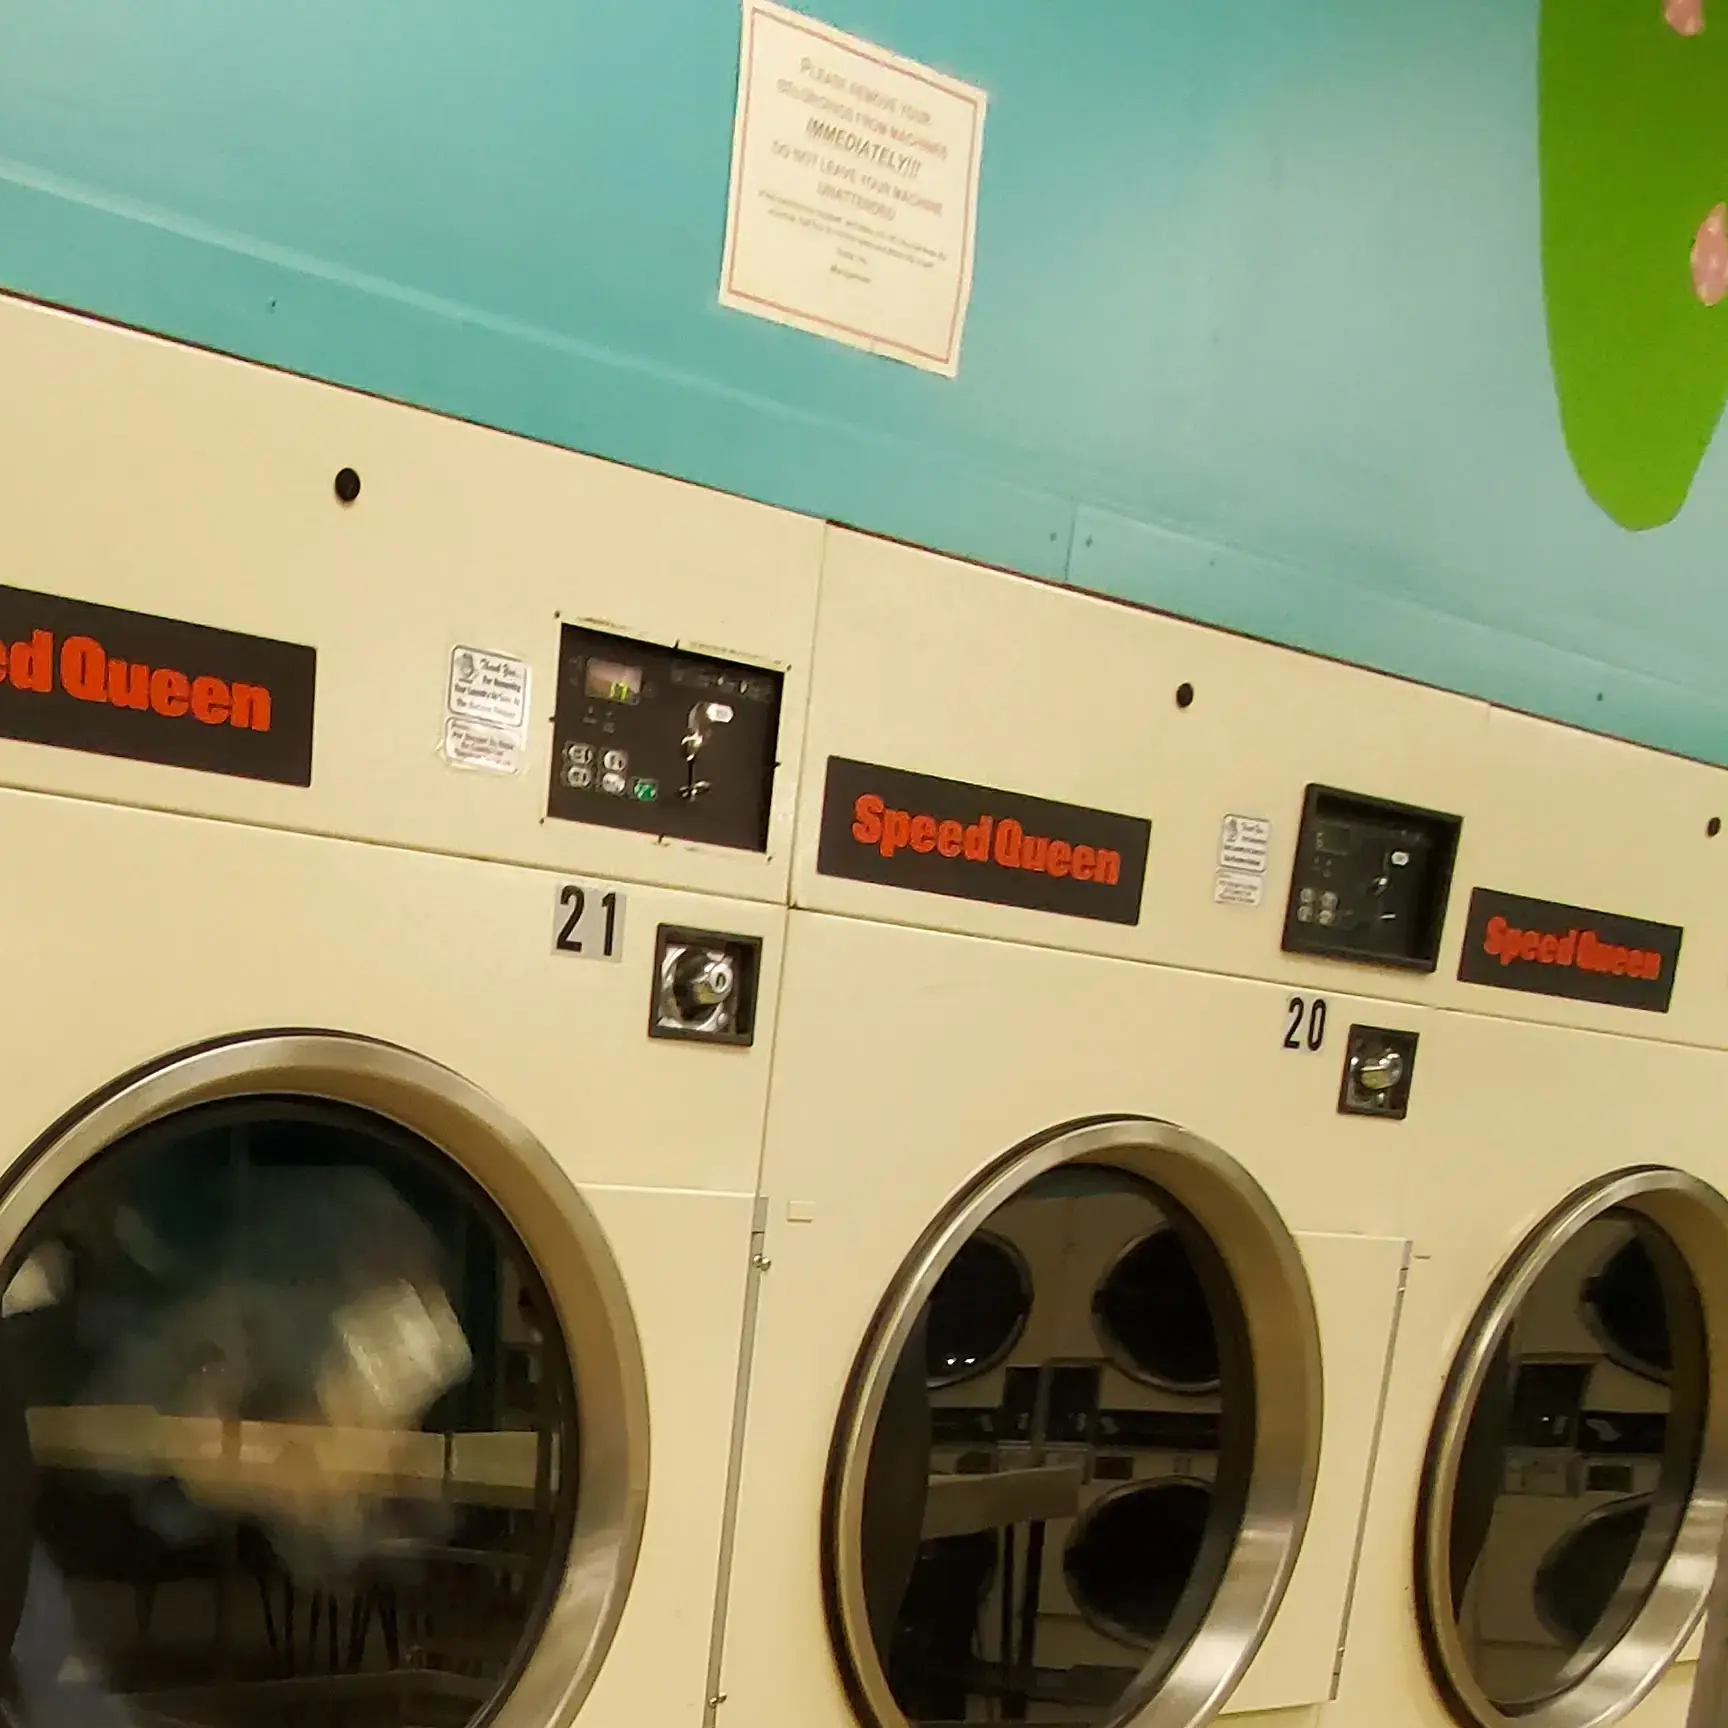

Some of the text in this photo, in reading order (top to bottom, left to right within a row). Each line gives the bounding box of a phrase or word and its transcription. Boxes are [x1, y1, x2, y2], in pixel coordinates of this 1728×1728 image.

[806, 116, 922, 178] IMMEDIATELY!!!
[59, 635, 272, 732] Queen
[852, 794, 1121, 886] Speed Queen
[556, 884, 617, 957] 21
[1484, 916, 1661, 981] Speed Queen
[1283, 996, 1327, 1052] 20
